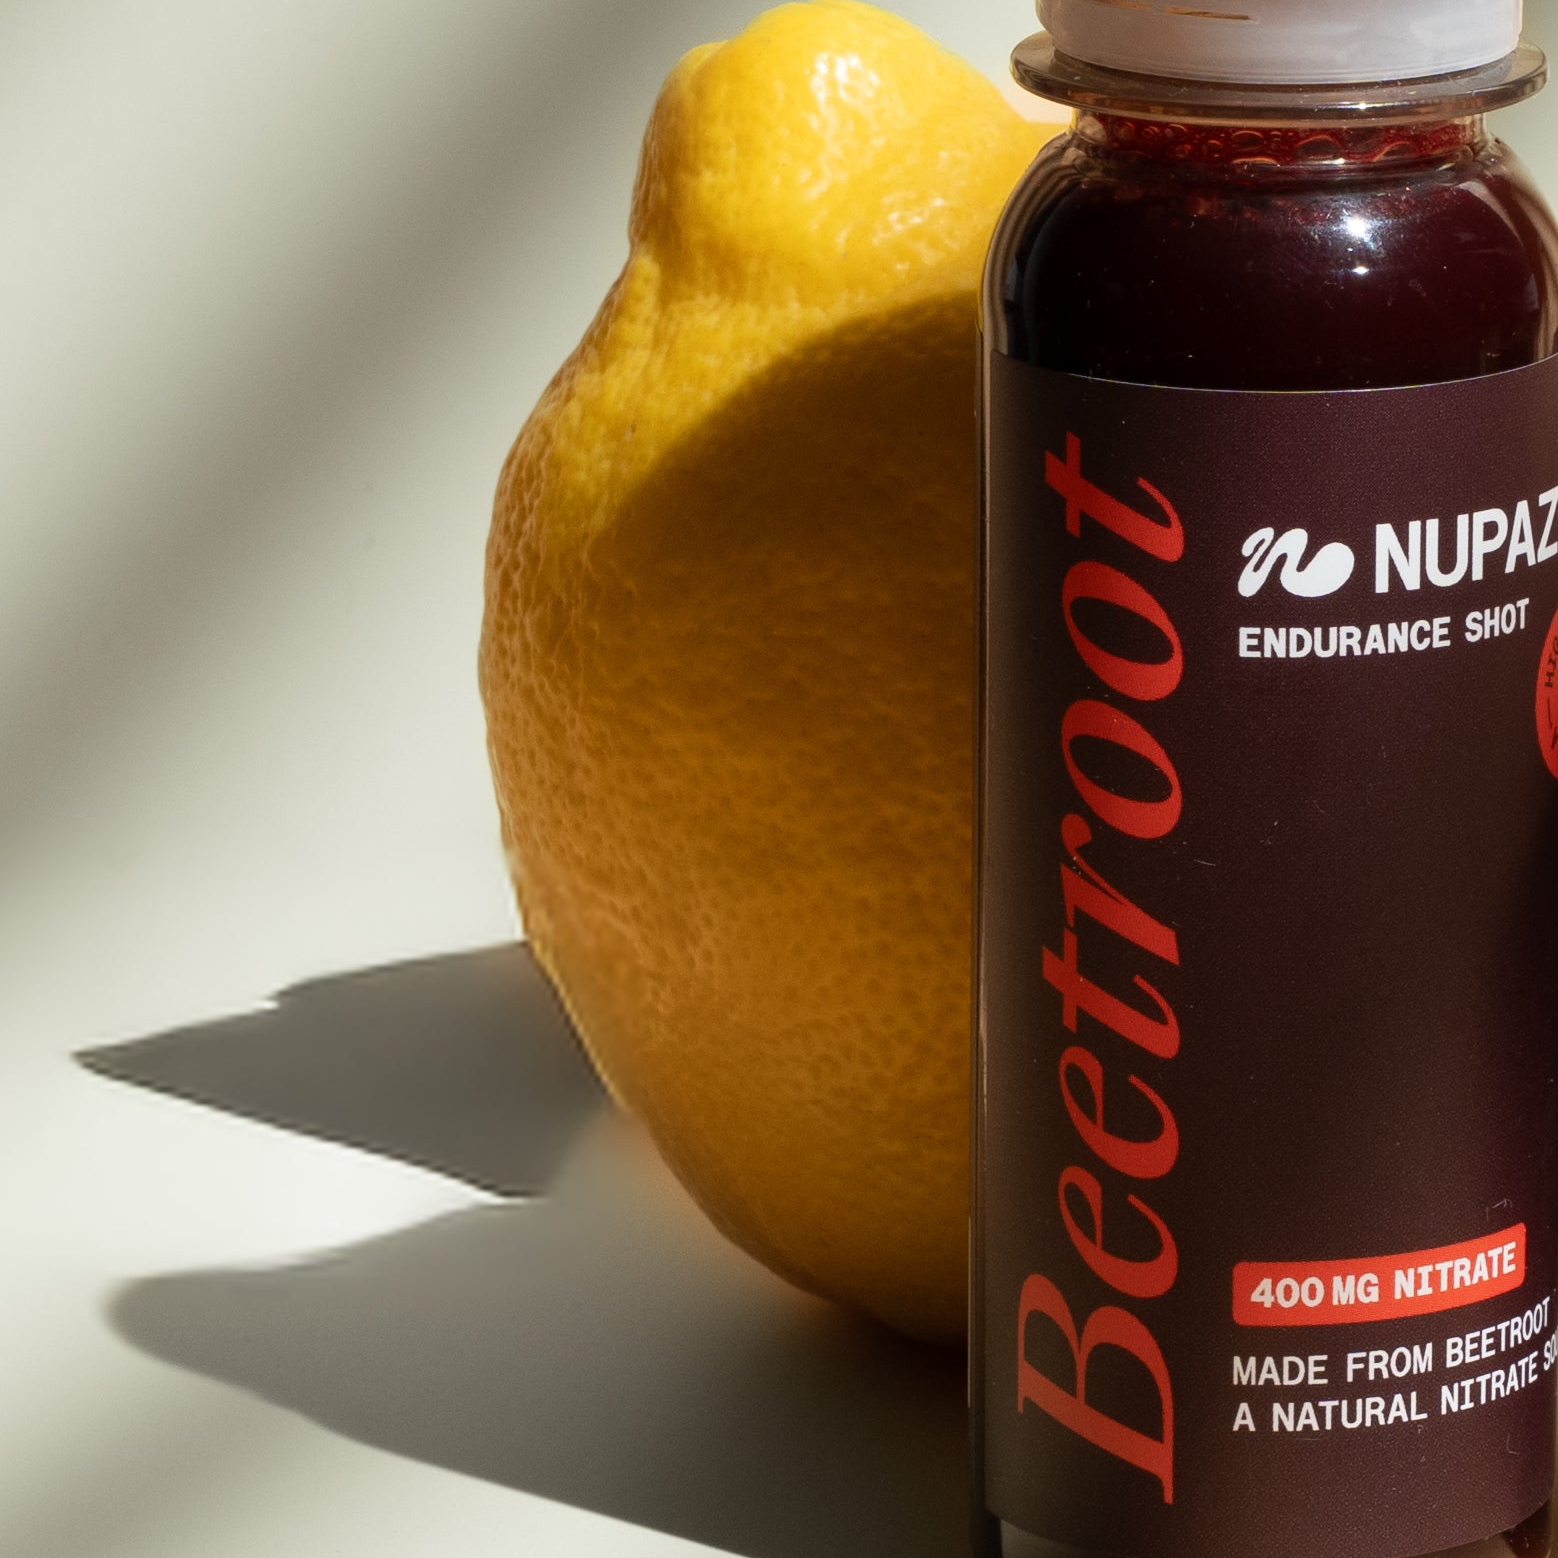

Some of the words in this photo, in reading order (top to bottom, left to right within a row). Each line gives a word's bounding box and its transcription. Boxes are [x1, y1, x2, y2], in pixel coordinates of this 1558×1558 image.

[1238, 616, 1451, 658] ENDURANCE
[1464, 597, 1530, 643] SHOT
[1016, 430, 1186, 1505] Beetroot
[1250, 1277, 1325, 1308] 400
[1332, 1272, 1379, 1306] MG
[1394, 1241, 1517, 1300] NITRATE
[1232, 1354, 1329, 1386] MADE
[1346, 1342, 1433, 1381] FROM
[1446, 1296, 1550, 1369] BEETROOT
[1232, 1401, 1256, 1432] A
[1272, 1391, 1428, 1432] NATURAL
[1440, 1350, 1539, 1416] NITRATE
